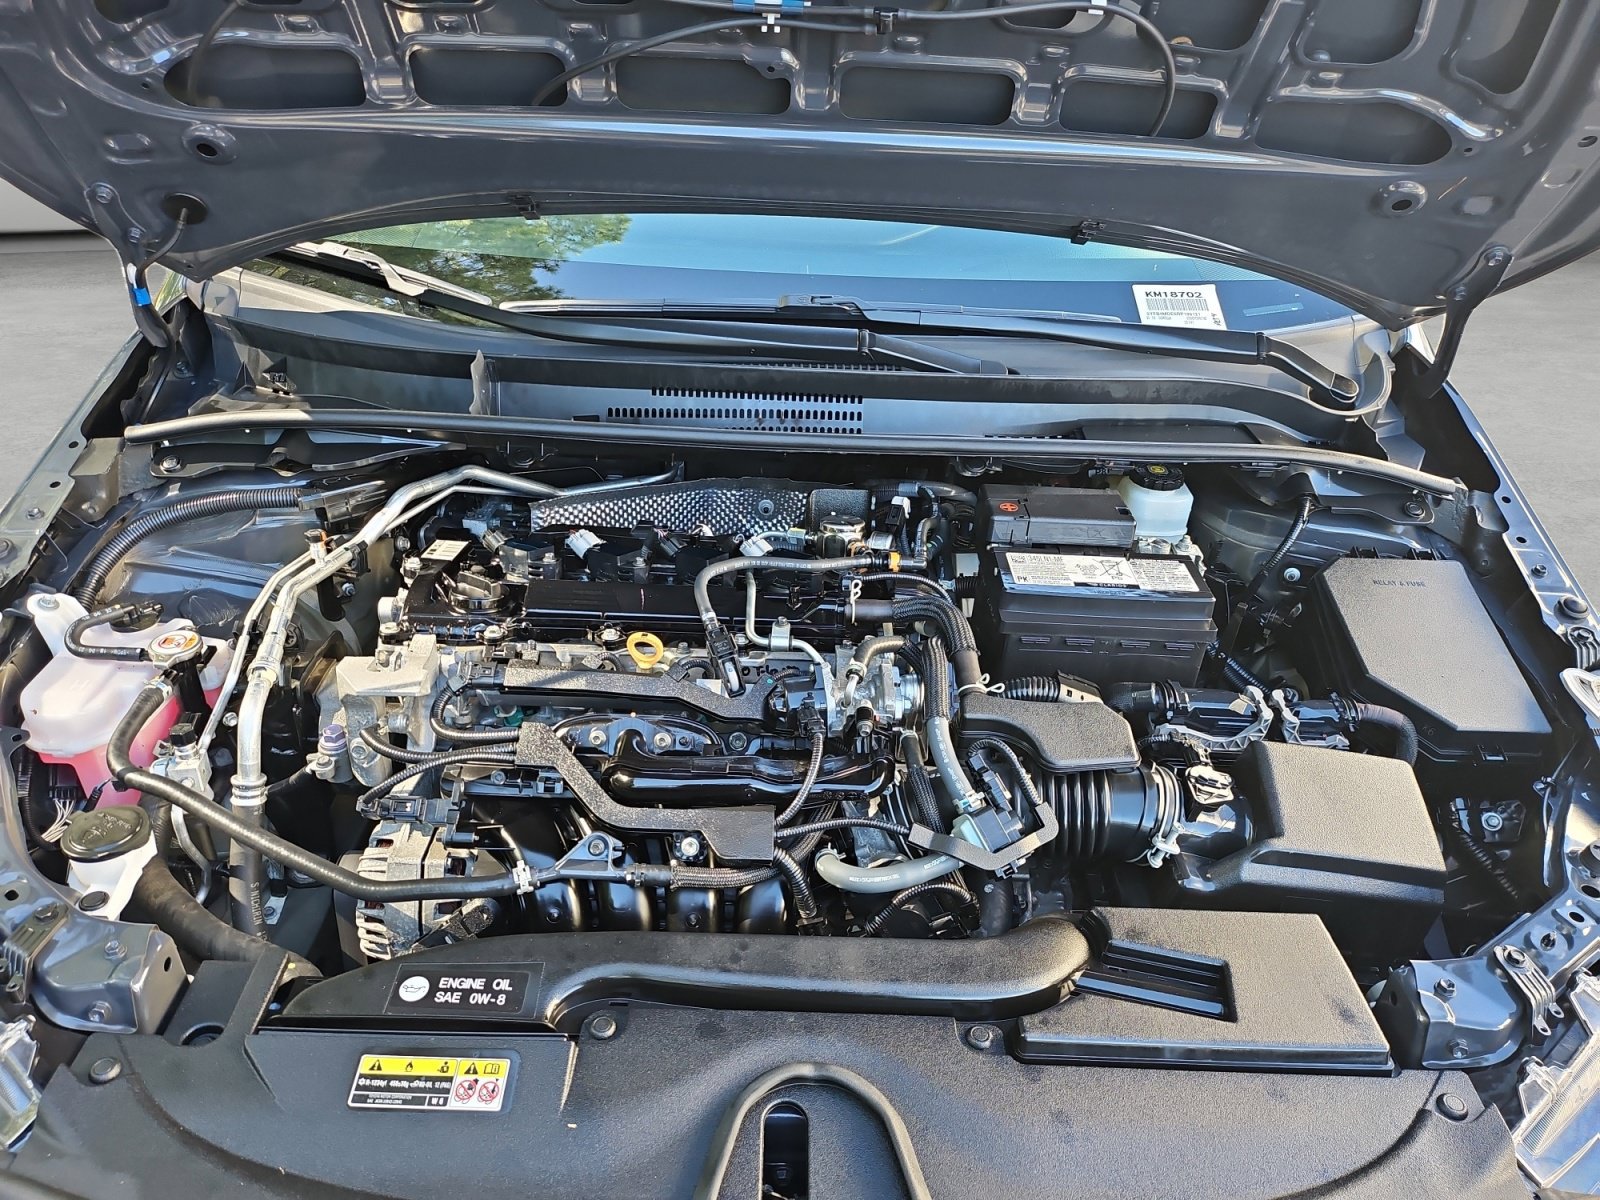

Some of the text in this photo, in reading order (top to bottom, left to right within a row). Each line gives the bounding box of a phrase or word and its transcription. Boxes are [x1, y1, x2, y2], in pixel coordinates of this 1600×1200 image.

[438, 977, 513, 991] ENGINE OIL
[434, 991, 506, 1006] SAE 0W-8
